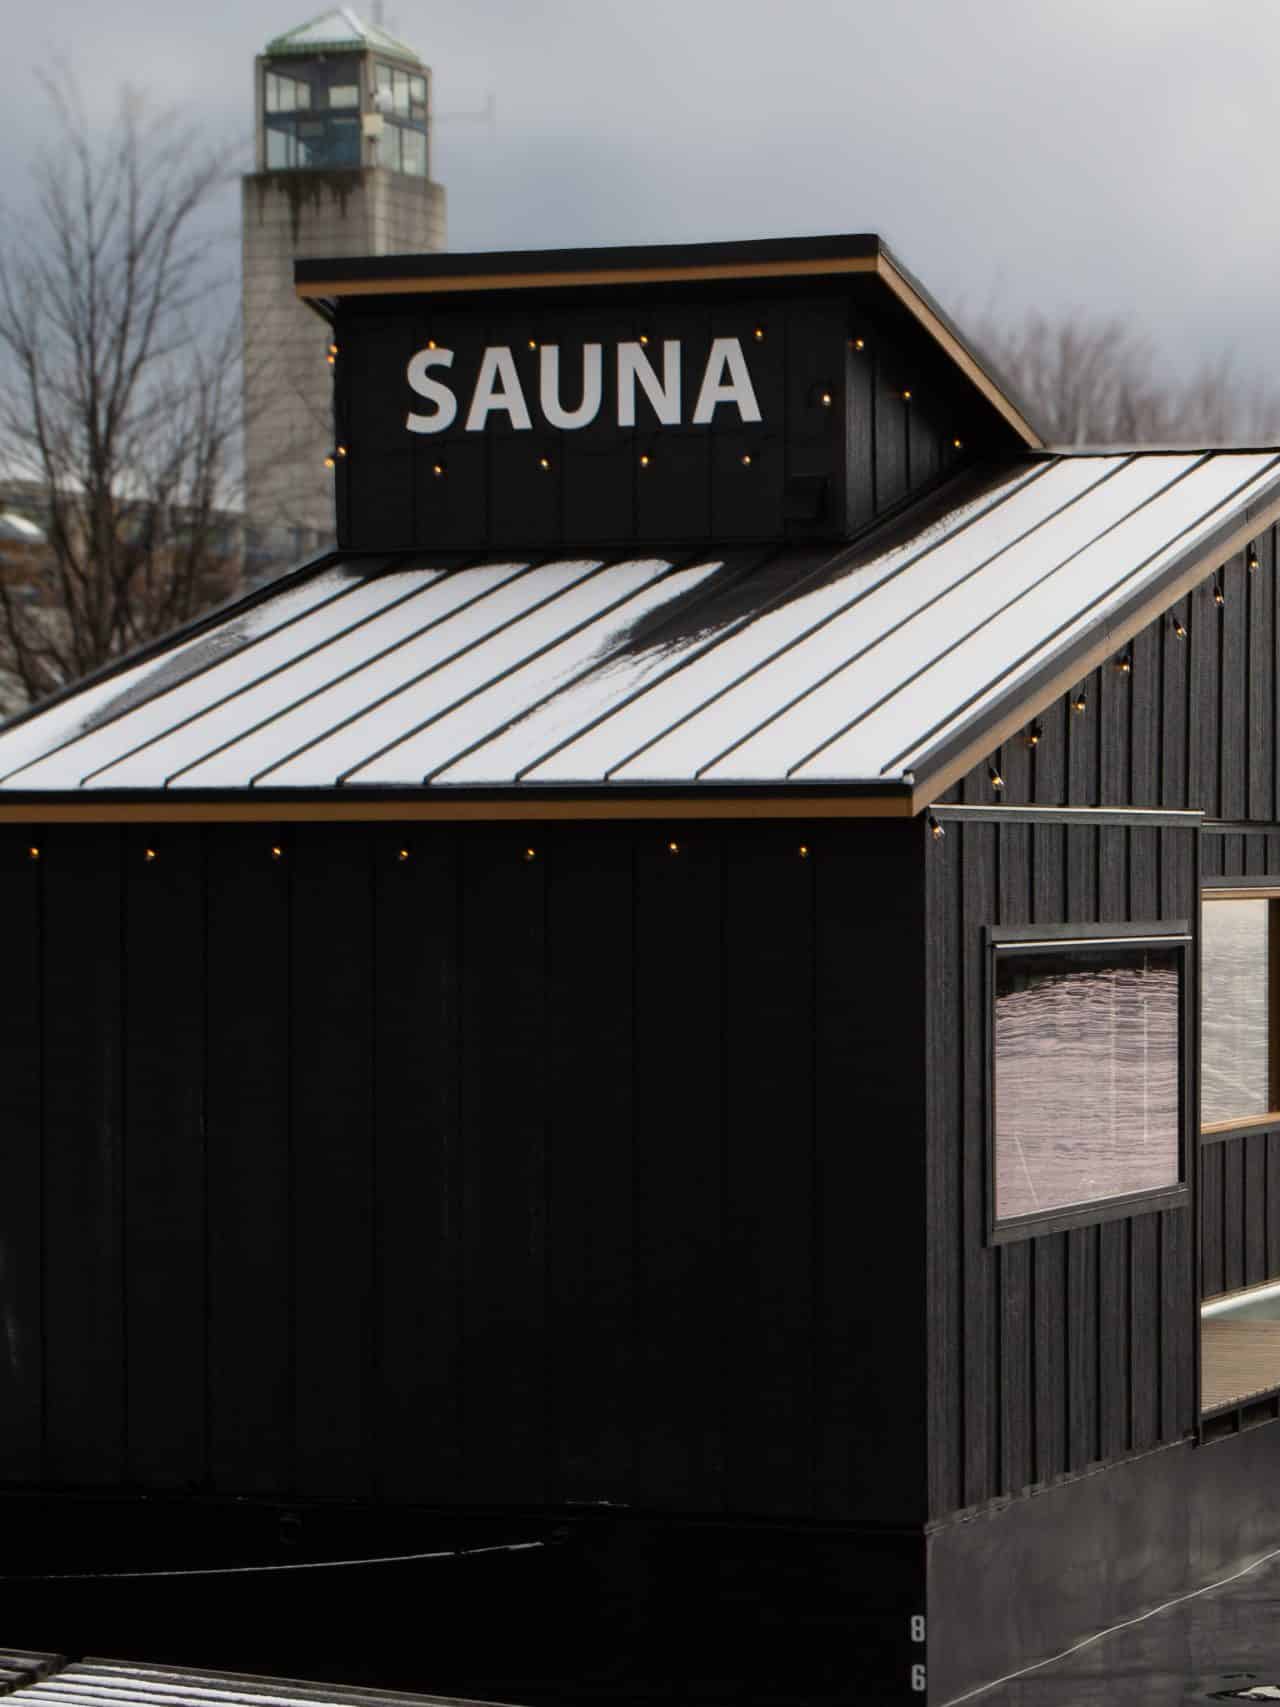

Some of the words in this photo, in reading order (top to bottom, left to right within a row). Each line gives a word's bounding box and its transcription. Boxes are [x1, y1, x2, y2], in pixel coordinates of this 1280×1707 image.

[406, 337, 762, 433] SAUNA
[911, 1615, 925, 1642] 8
[911, 1664, 925, 1691] 6
